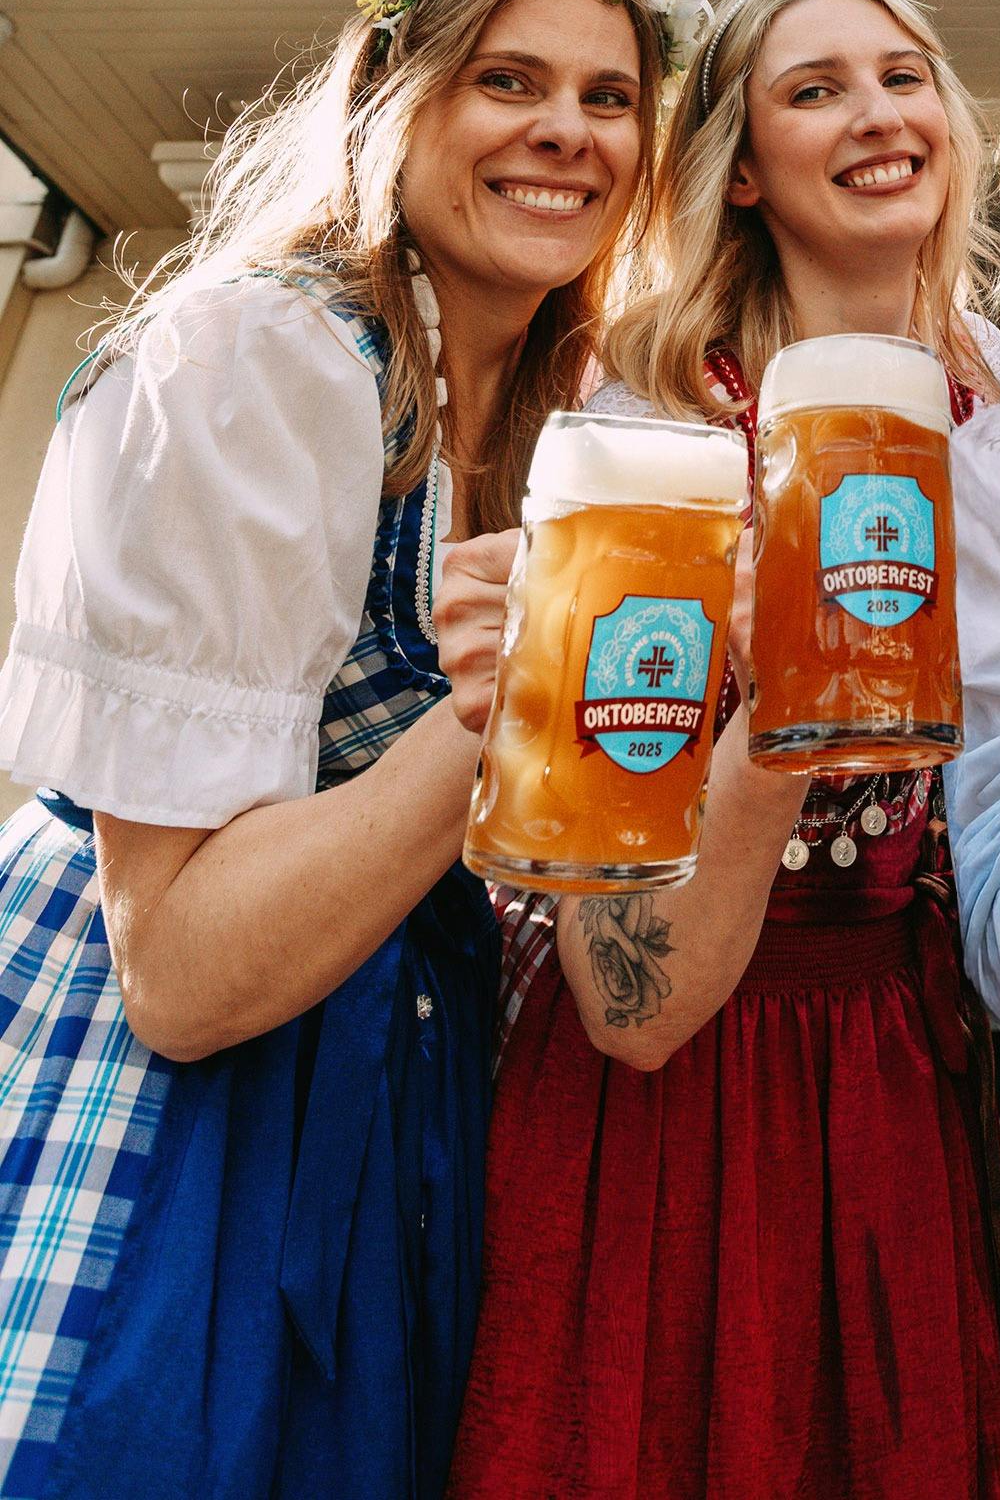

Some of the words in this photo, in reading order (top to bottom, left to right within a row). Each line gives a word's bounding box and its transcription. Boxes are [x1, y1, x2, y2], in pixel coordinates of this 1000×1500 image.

[823, 565, 934, 594] OKTOBERFEST
[867, 600, 899, 613] 2025
[584, 702, 702, 730] OKTOBERFEST
[628, 742, 663, 758] 2025
